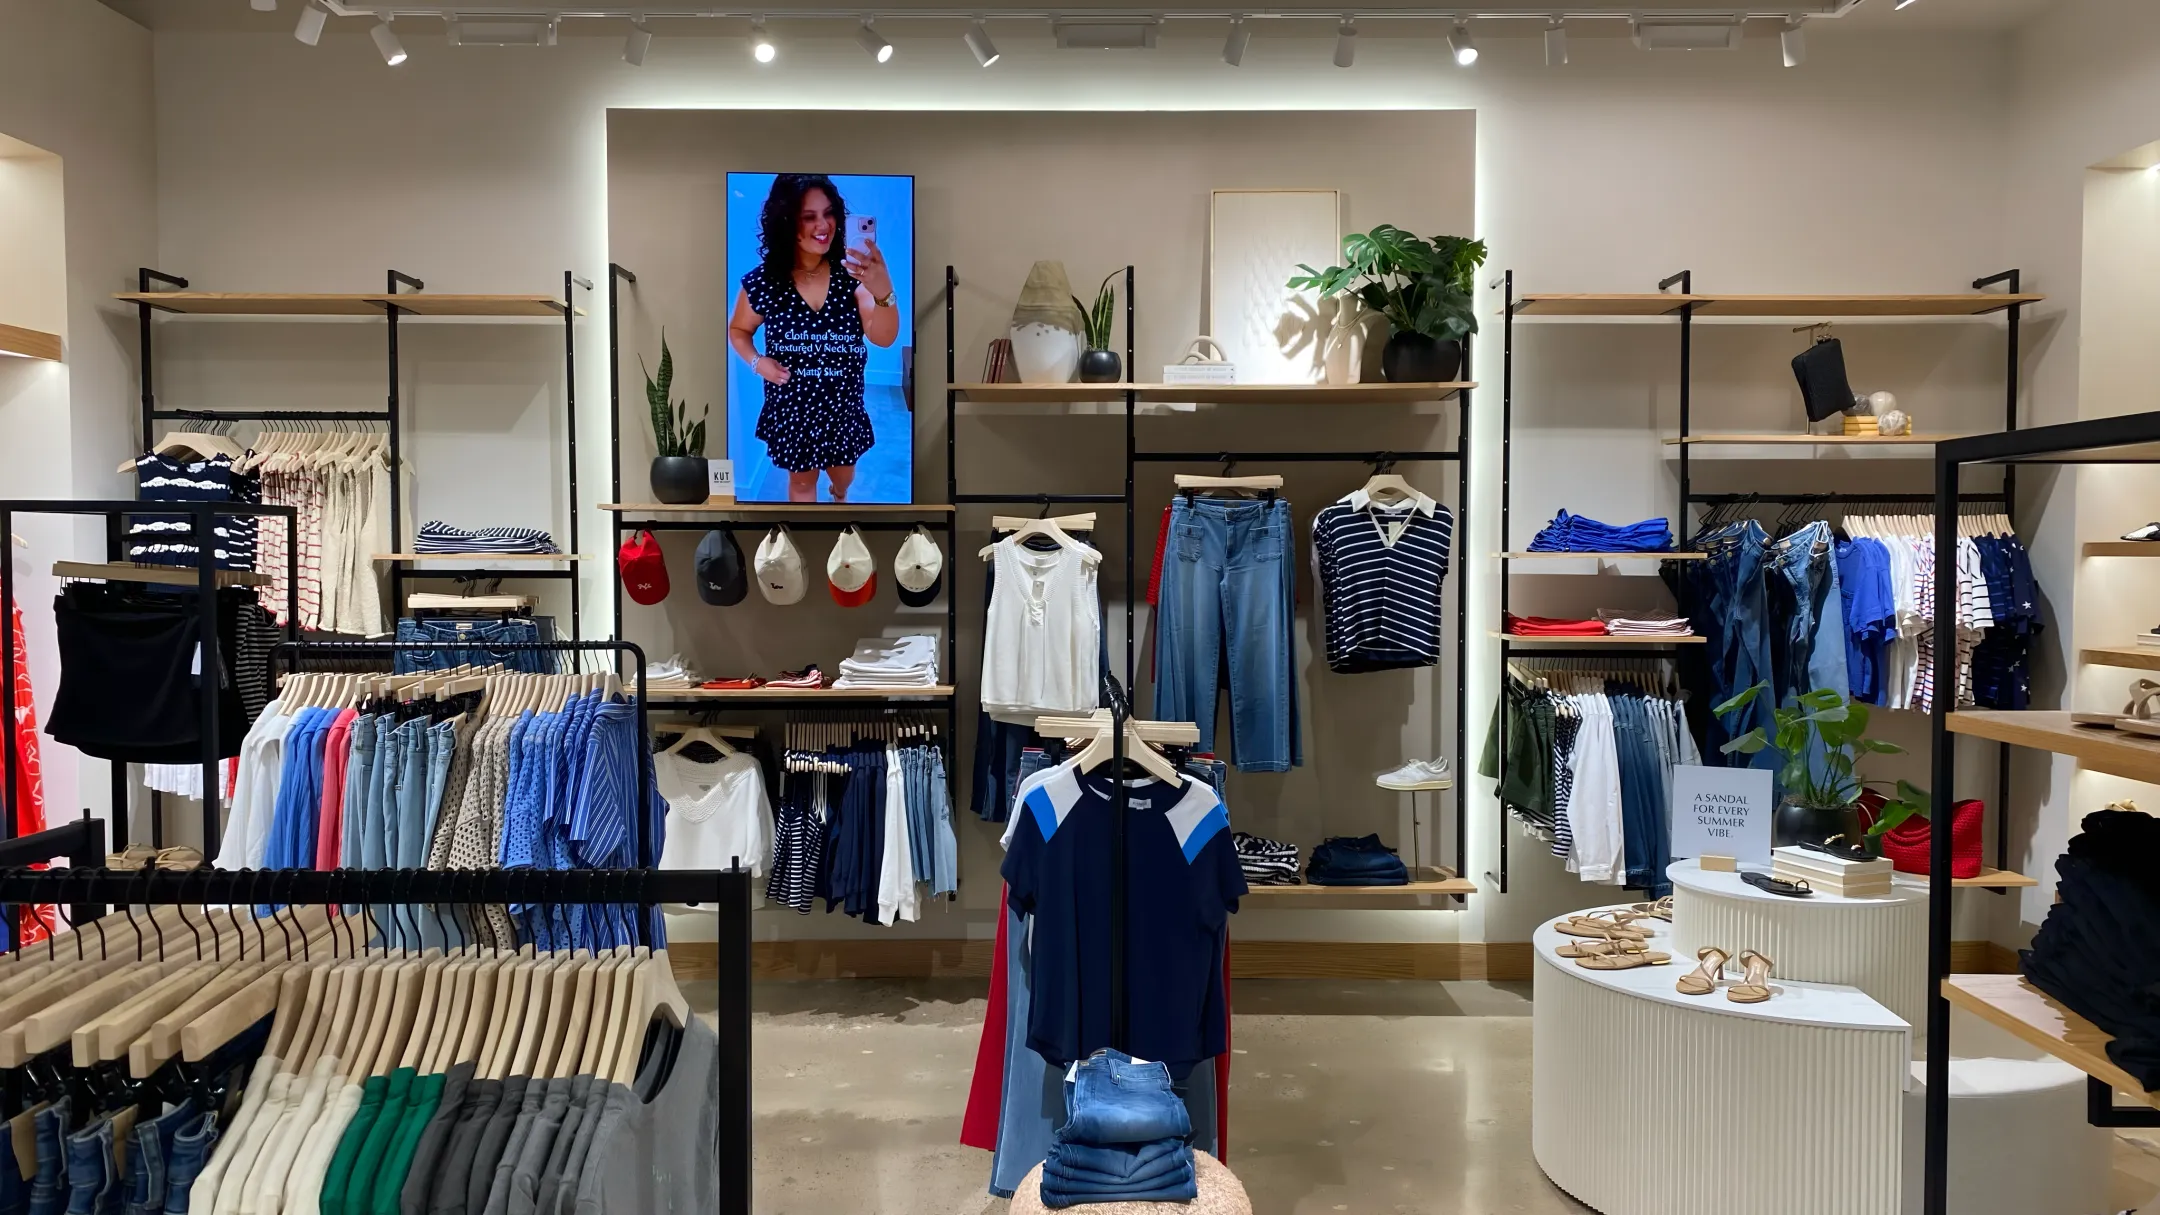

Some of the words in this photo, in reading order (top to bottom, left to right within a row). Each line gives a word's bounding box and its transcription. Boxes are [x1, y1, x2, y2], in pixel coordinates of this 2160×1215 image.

[785, 331, 808, 340] Cloth
[811, 332, 827, 340] and
[830, 332, 855, 341] Stone
[774, 343, 813, 352] Textured
[815, 344, 822, 352] V
[824, 344, 847, 352] Neck
[848, 345, 866, 355] Top
[796, 368, 822, 378] Matty
[824, 367, 843, 376] Skirt
[714, 471, 730, 480] KUT
[1694, 793, 1702, 801] A
[1705, 793, 1749, 804] SANDAL
[1693, 804, 1714, 814] FOR
[1718, 805, 1750, 816] EVERY
[1697, 815, 1745, 827] SUMMER
[1707, 827, 1734, 838] VIBE.
